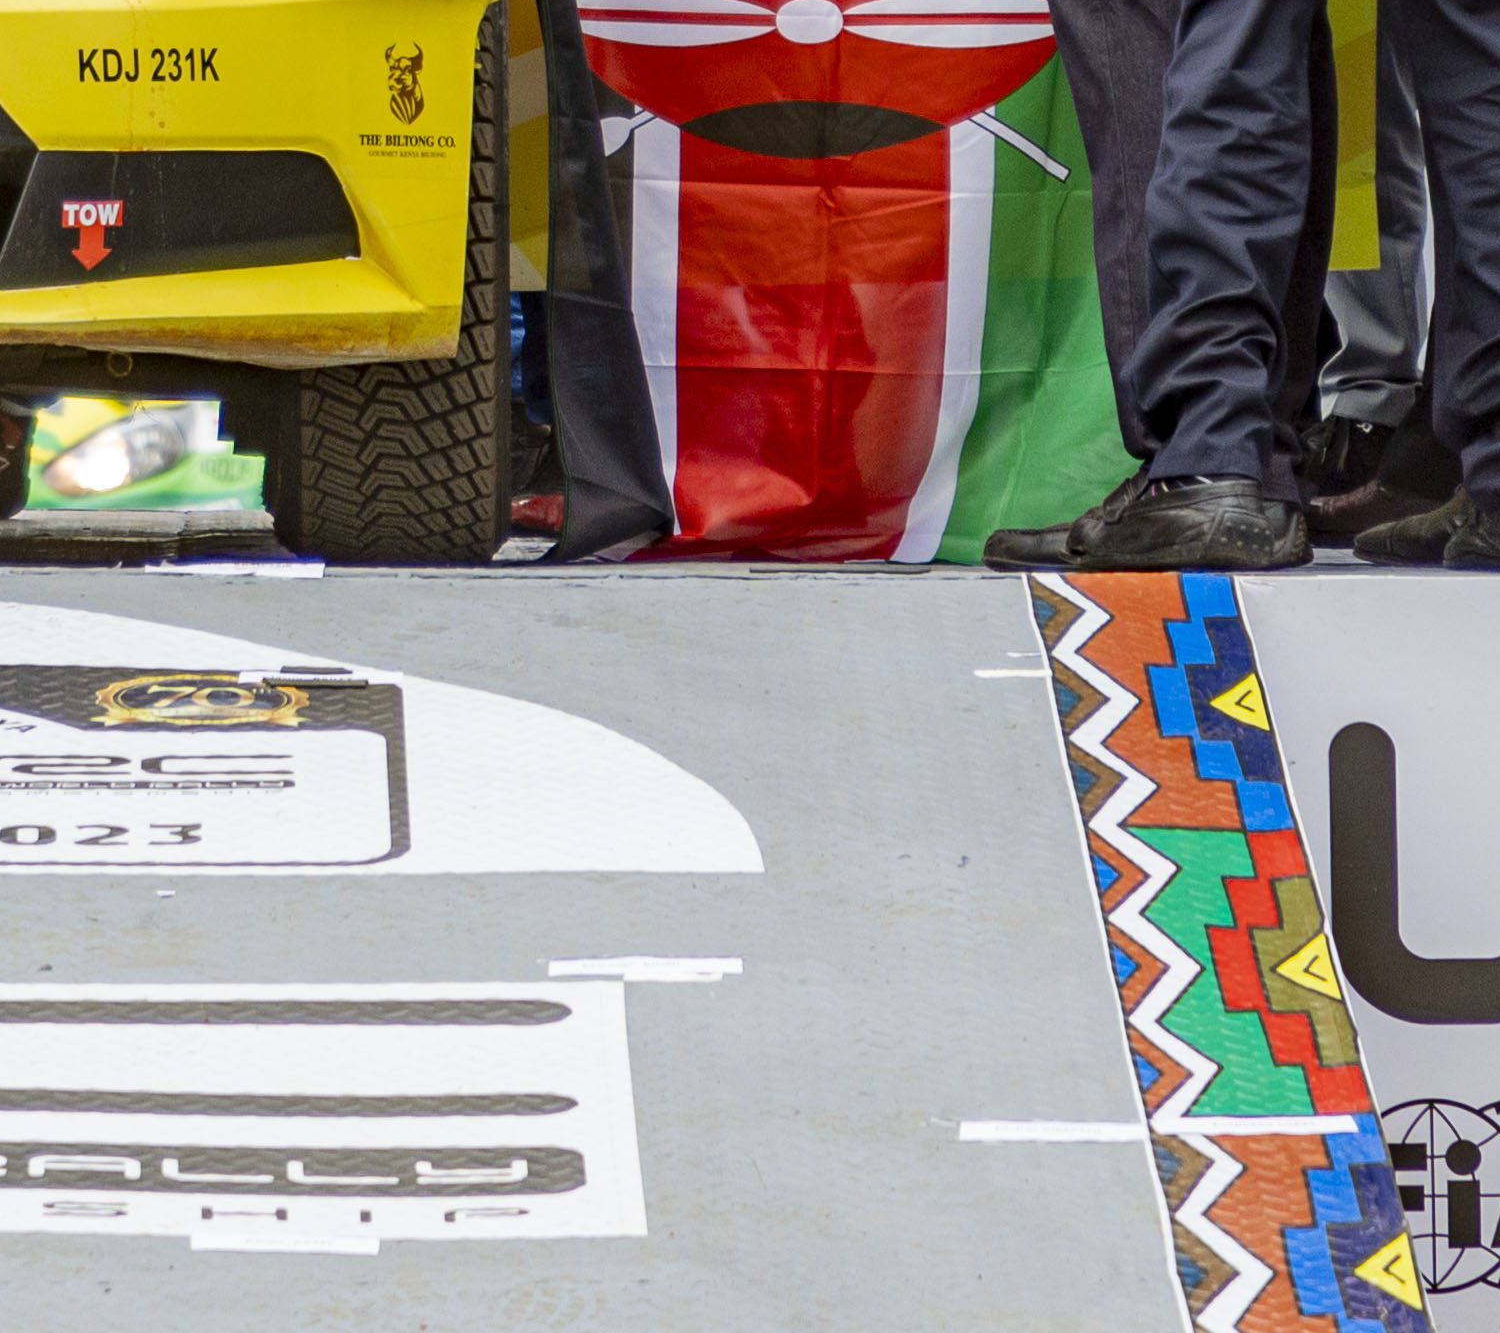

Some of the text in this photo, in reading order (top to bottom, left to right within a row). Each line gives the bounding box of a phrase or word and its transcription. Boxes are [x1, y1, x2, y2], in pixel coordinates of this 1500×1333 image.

[79, 48, 219, 82] KDJ 231K
[360, 135, 456, 147] THE BILTONG CO.
[64, 203, 119, 226] TOW
